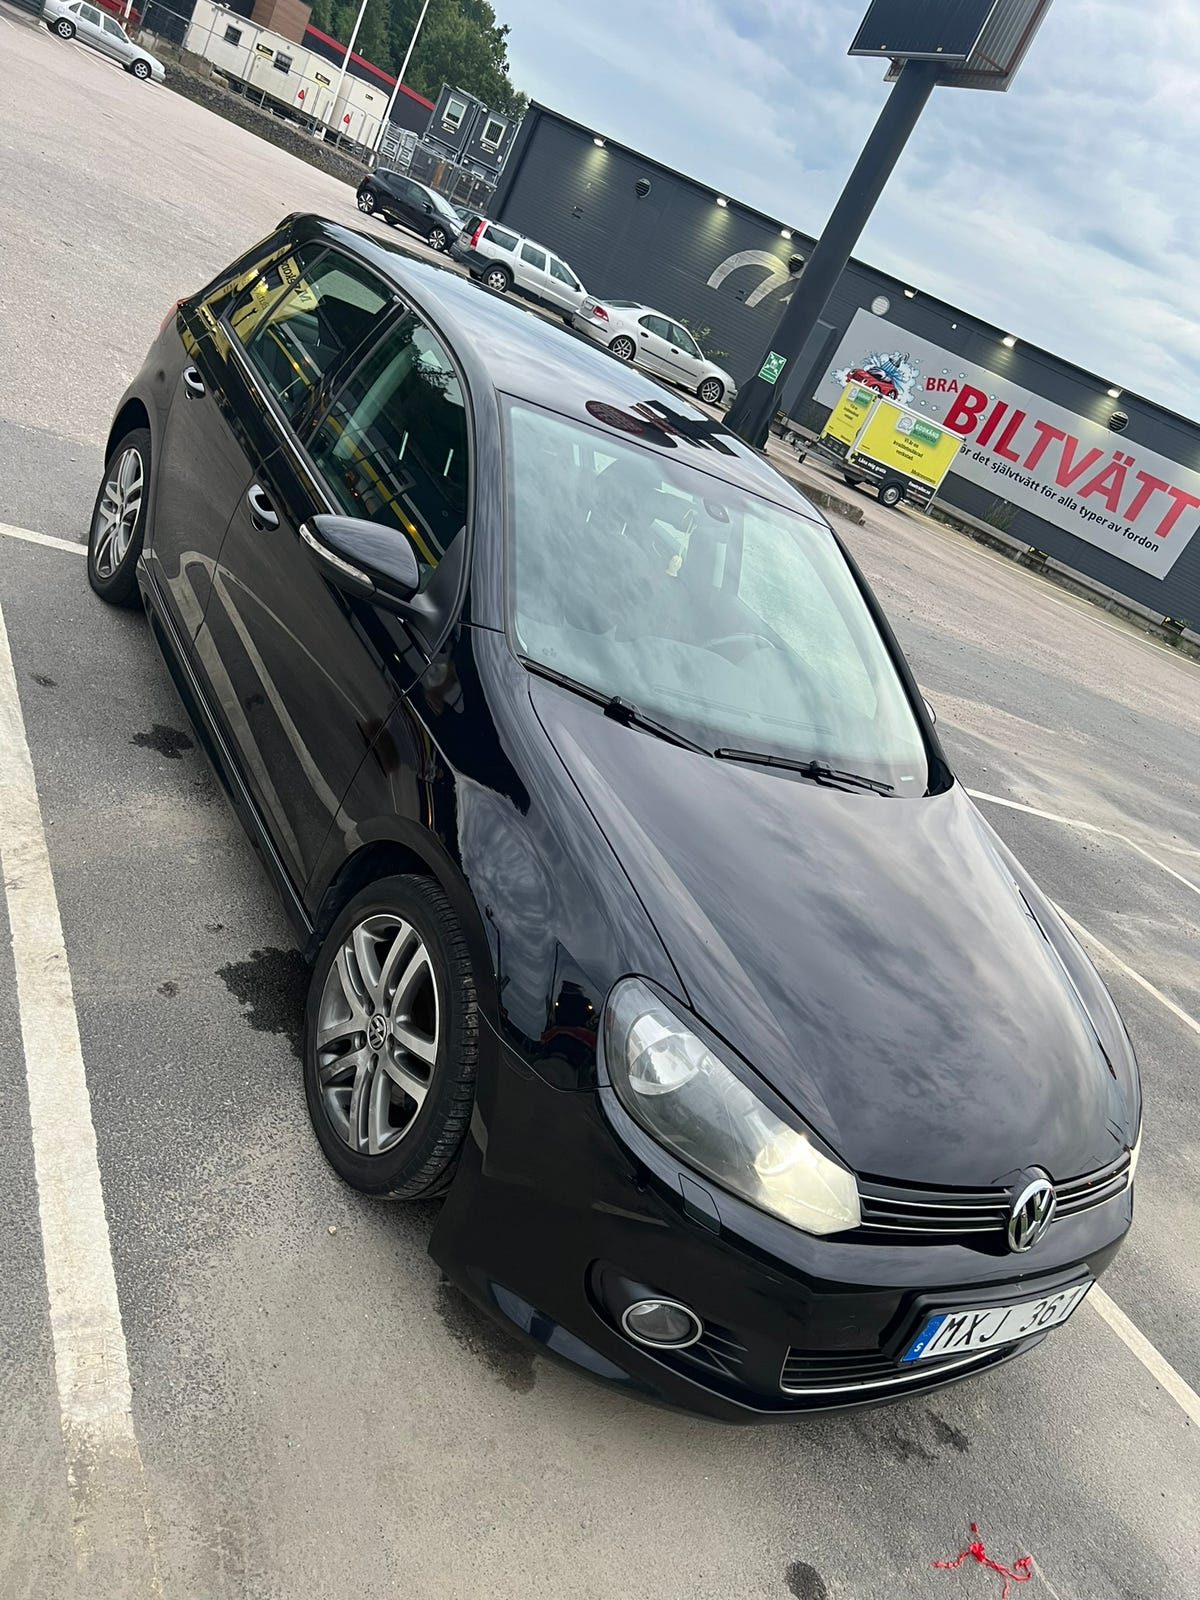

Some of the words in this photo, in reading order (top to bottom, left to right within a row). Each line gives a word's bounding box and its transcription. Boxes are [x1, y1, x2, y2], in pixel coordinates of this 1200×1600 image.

[926, 377, 959, 393] BRA
[943, 384, 1200, 539] BILTVÄTT
[960, 443, 972, 456] ör
[972, 452, 990, 466] det
[991, 462, 1040, 492] självtvätt
[1040, 485, 1058, 499] för
[1057, 495, 1077, 511] alla
[1079, 506, 1108, 526] typer
[1107, 522, 1122, 533] av
[1122, 527, 1160, 553] fordon
[930, 1310, 1011, 1351] MXJ
[1020, 1288, 1081, 1332] 361
